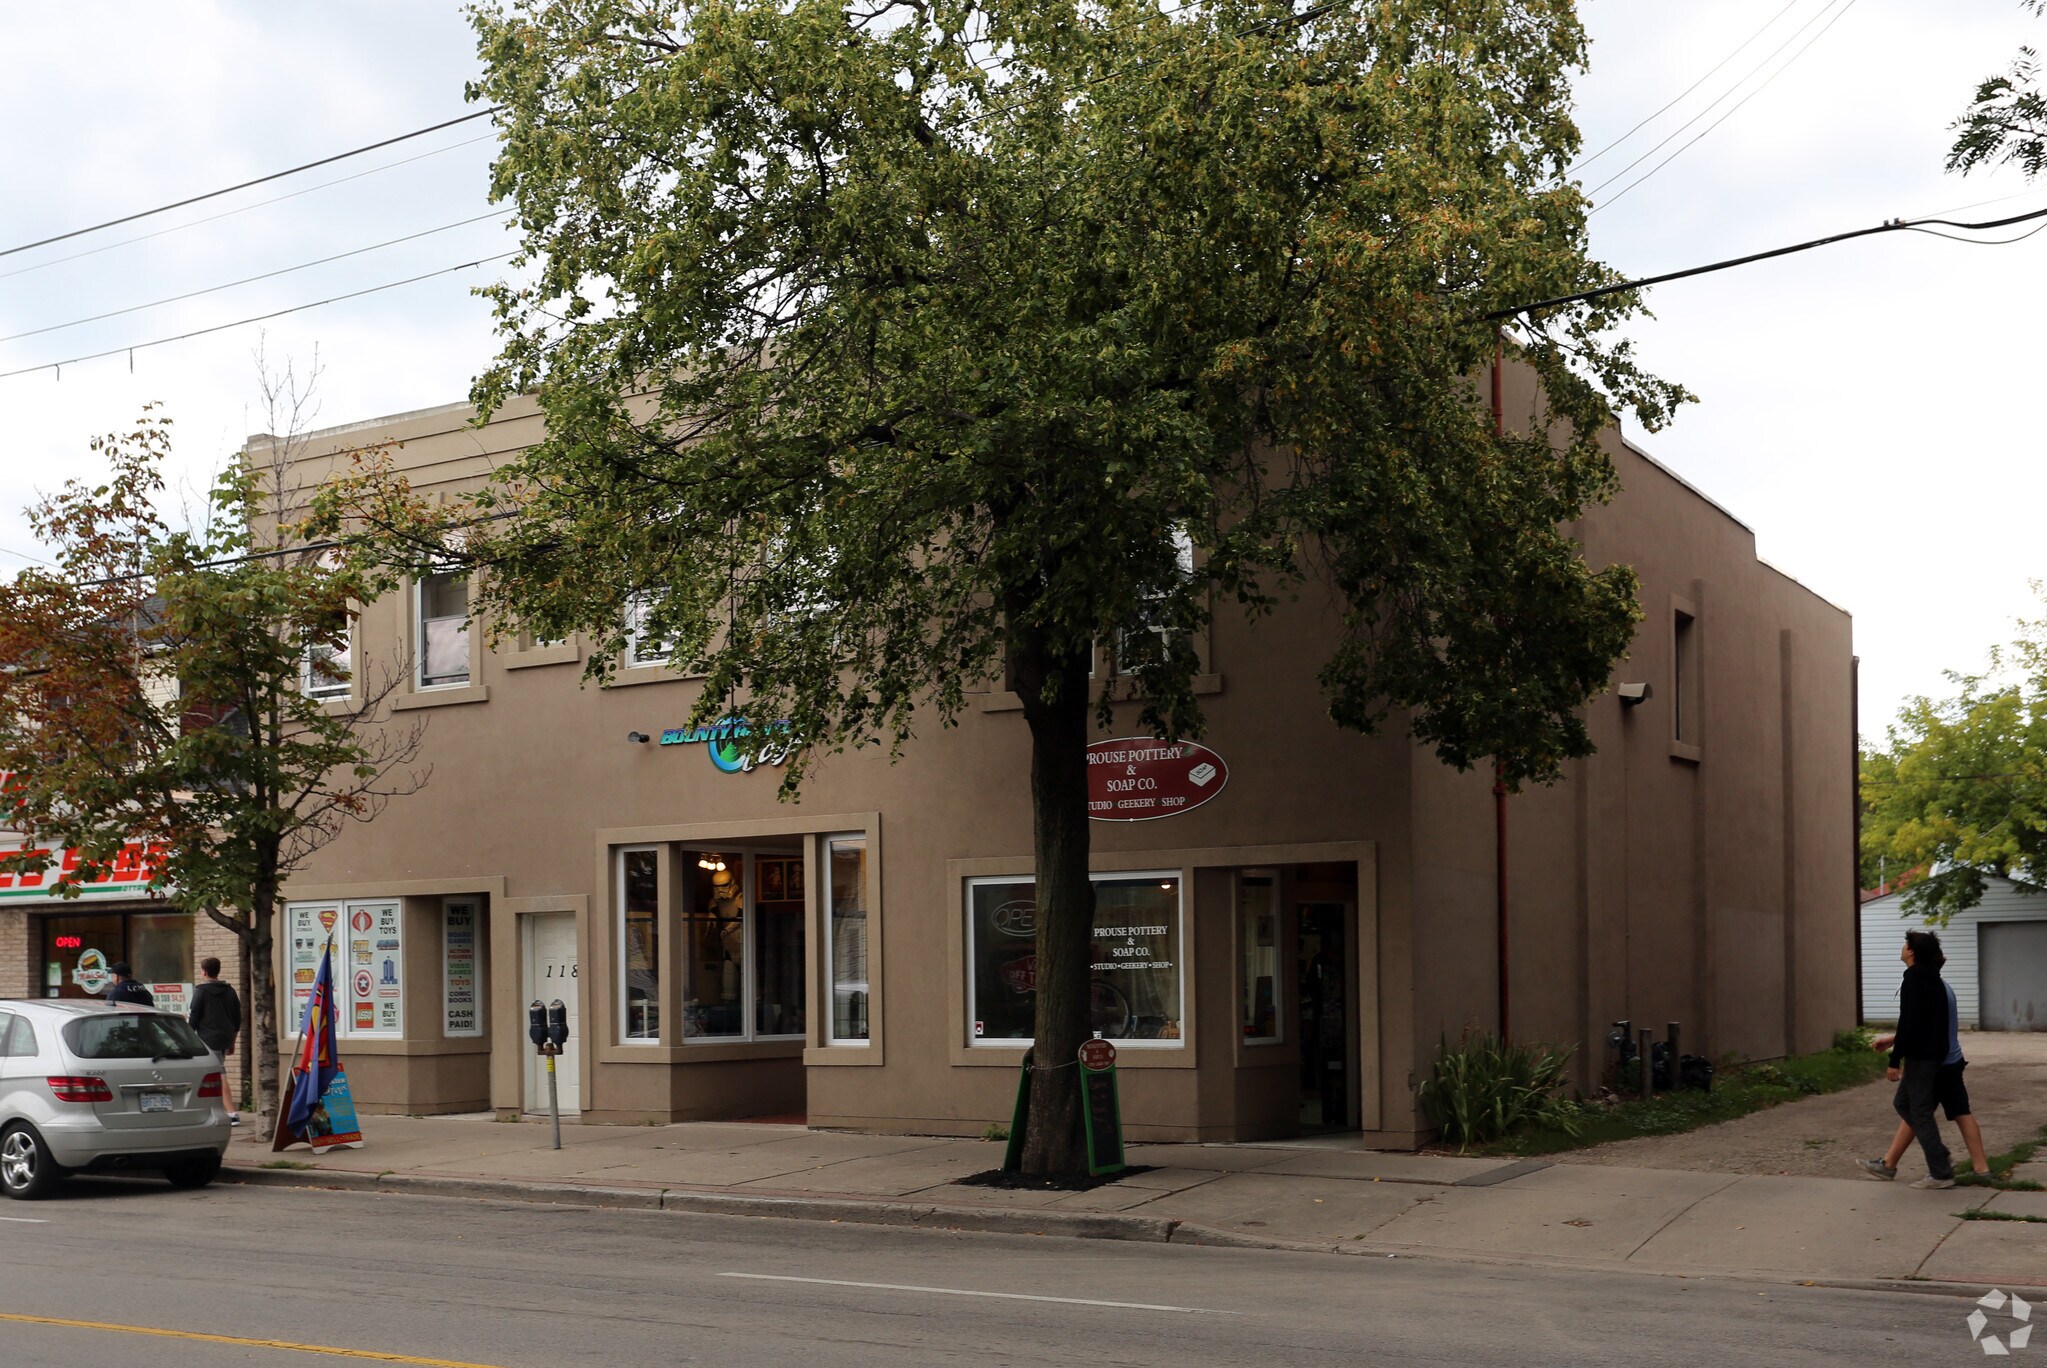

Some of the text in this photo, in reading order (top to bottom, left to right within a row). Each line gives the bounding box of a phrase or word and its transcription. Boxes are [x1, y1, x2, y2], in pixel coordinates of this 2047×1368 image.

[660, 725, 731, 745] BOUNTY
[1129, 747, 1183, 762] POTTERY
[1126, 764, 1136, 775] &
[1107, 777, 1158, 792] SOAP CO.
[1088, 796, 1186, 811] TUDIO GEEKERY SHOP
[299, 911, 310, 919] WE
[450, 905, 469, 915] WE
[380, 917, 395, 925] BUY
[448, 916, 471, 926] BUY
[995, 908, 1037, 927] OPE
[298, 919, 311, 927] BUY
[379, 926, 397, 935] TOYS
[1093, 925, 1168, 937] PROUSE POTTERY
[55, 936, 81, 948] OPEN
[1127, 937, 1135, 945] &
[1112, 947, 1150, 957] SOAP CO.
[382, 1010, 396, 1018] BUY
[448, 1010, 473, 1018] CASH
[449, 1020, 473, 1028] PAID!
